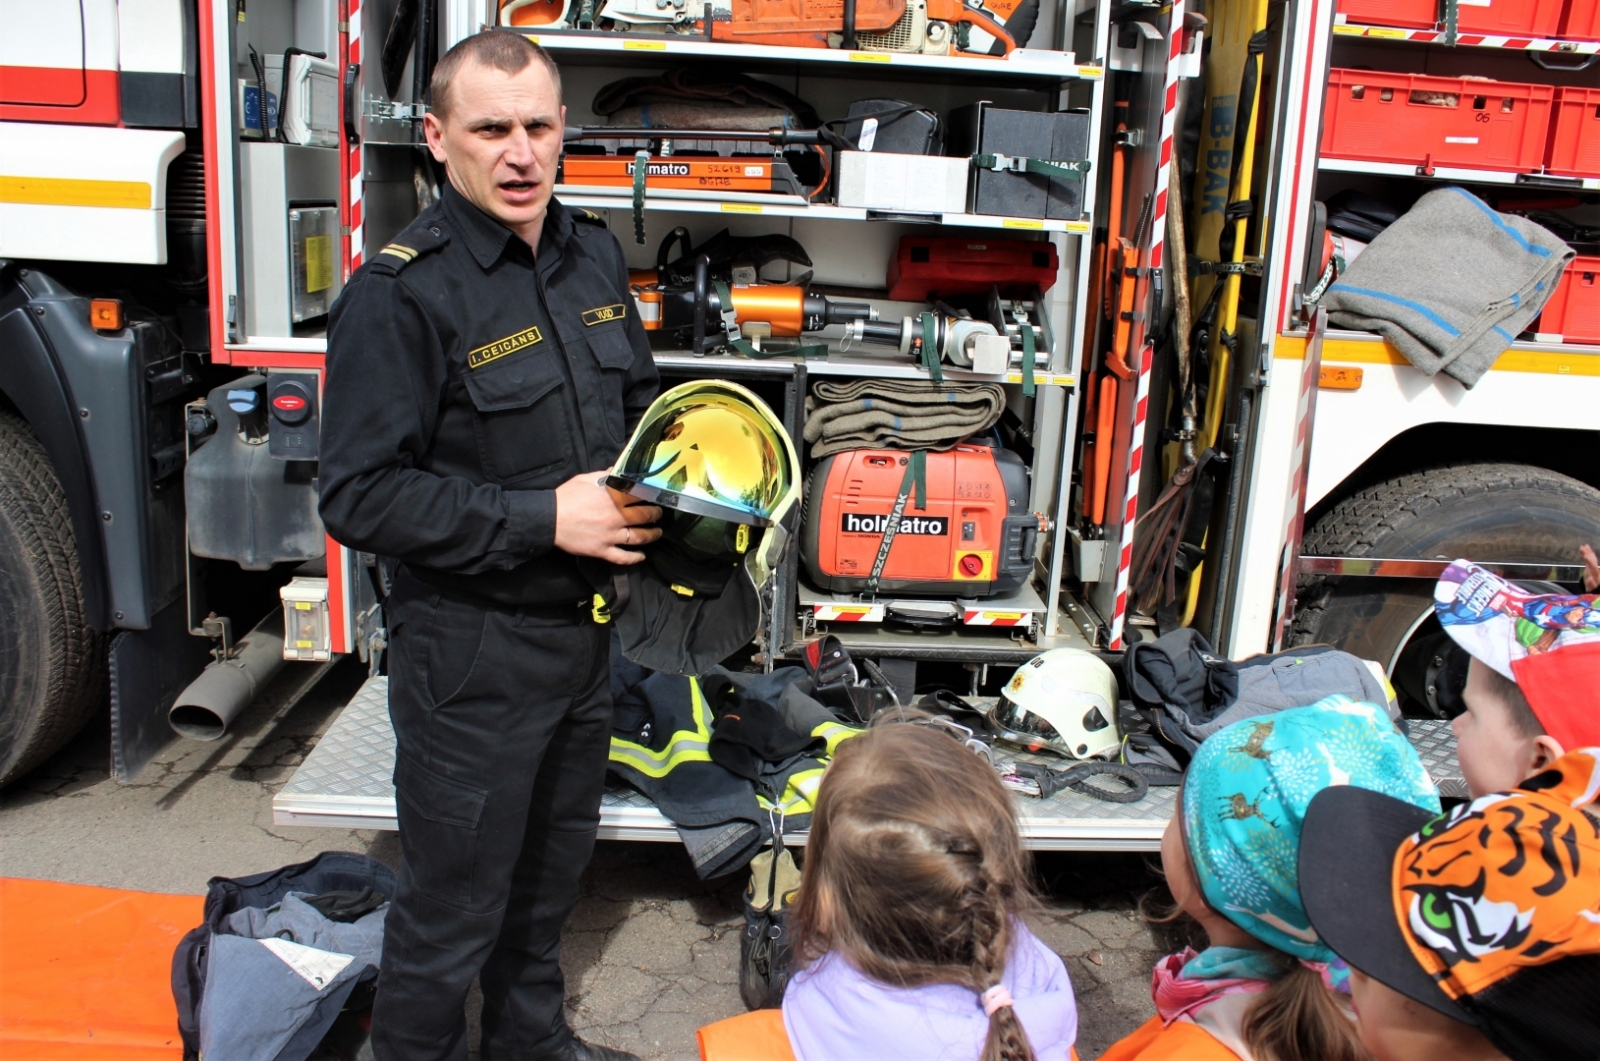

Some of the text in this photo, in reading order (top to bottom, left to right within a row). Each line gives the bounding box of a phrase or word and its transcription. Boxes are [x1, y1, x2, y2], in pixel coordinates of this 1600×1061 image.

[627, 163, 688, 176] hmatro
[1201, 113, 1234, 216] B-BAK
[471, 355, 481, 364] I.
